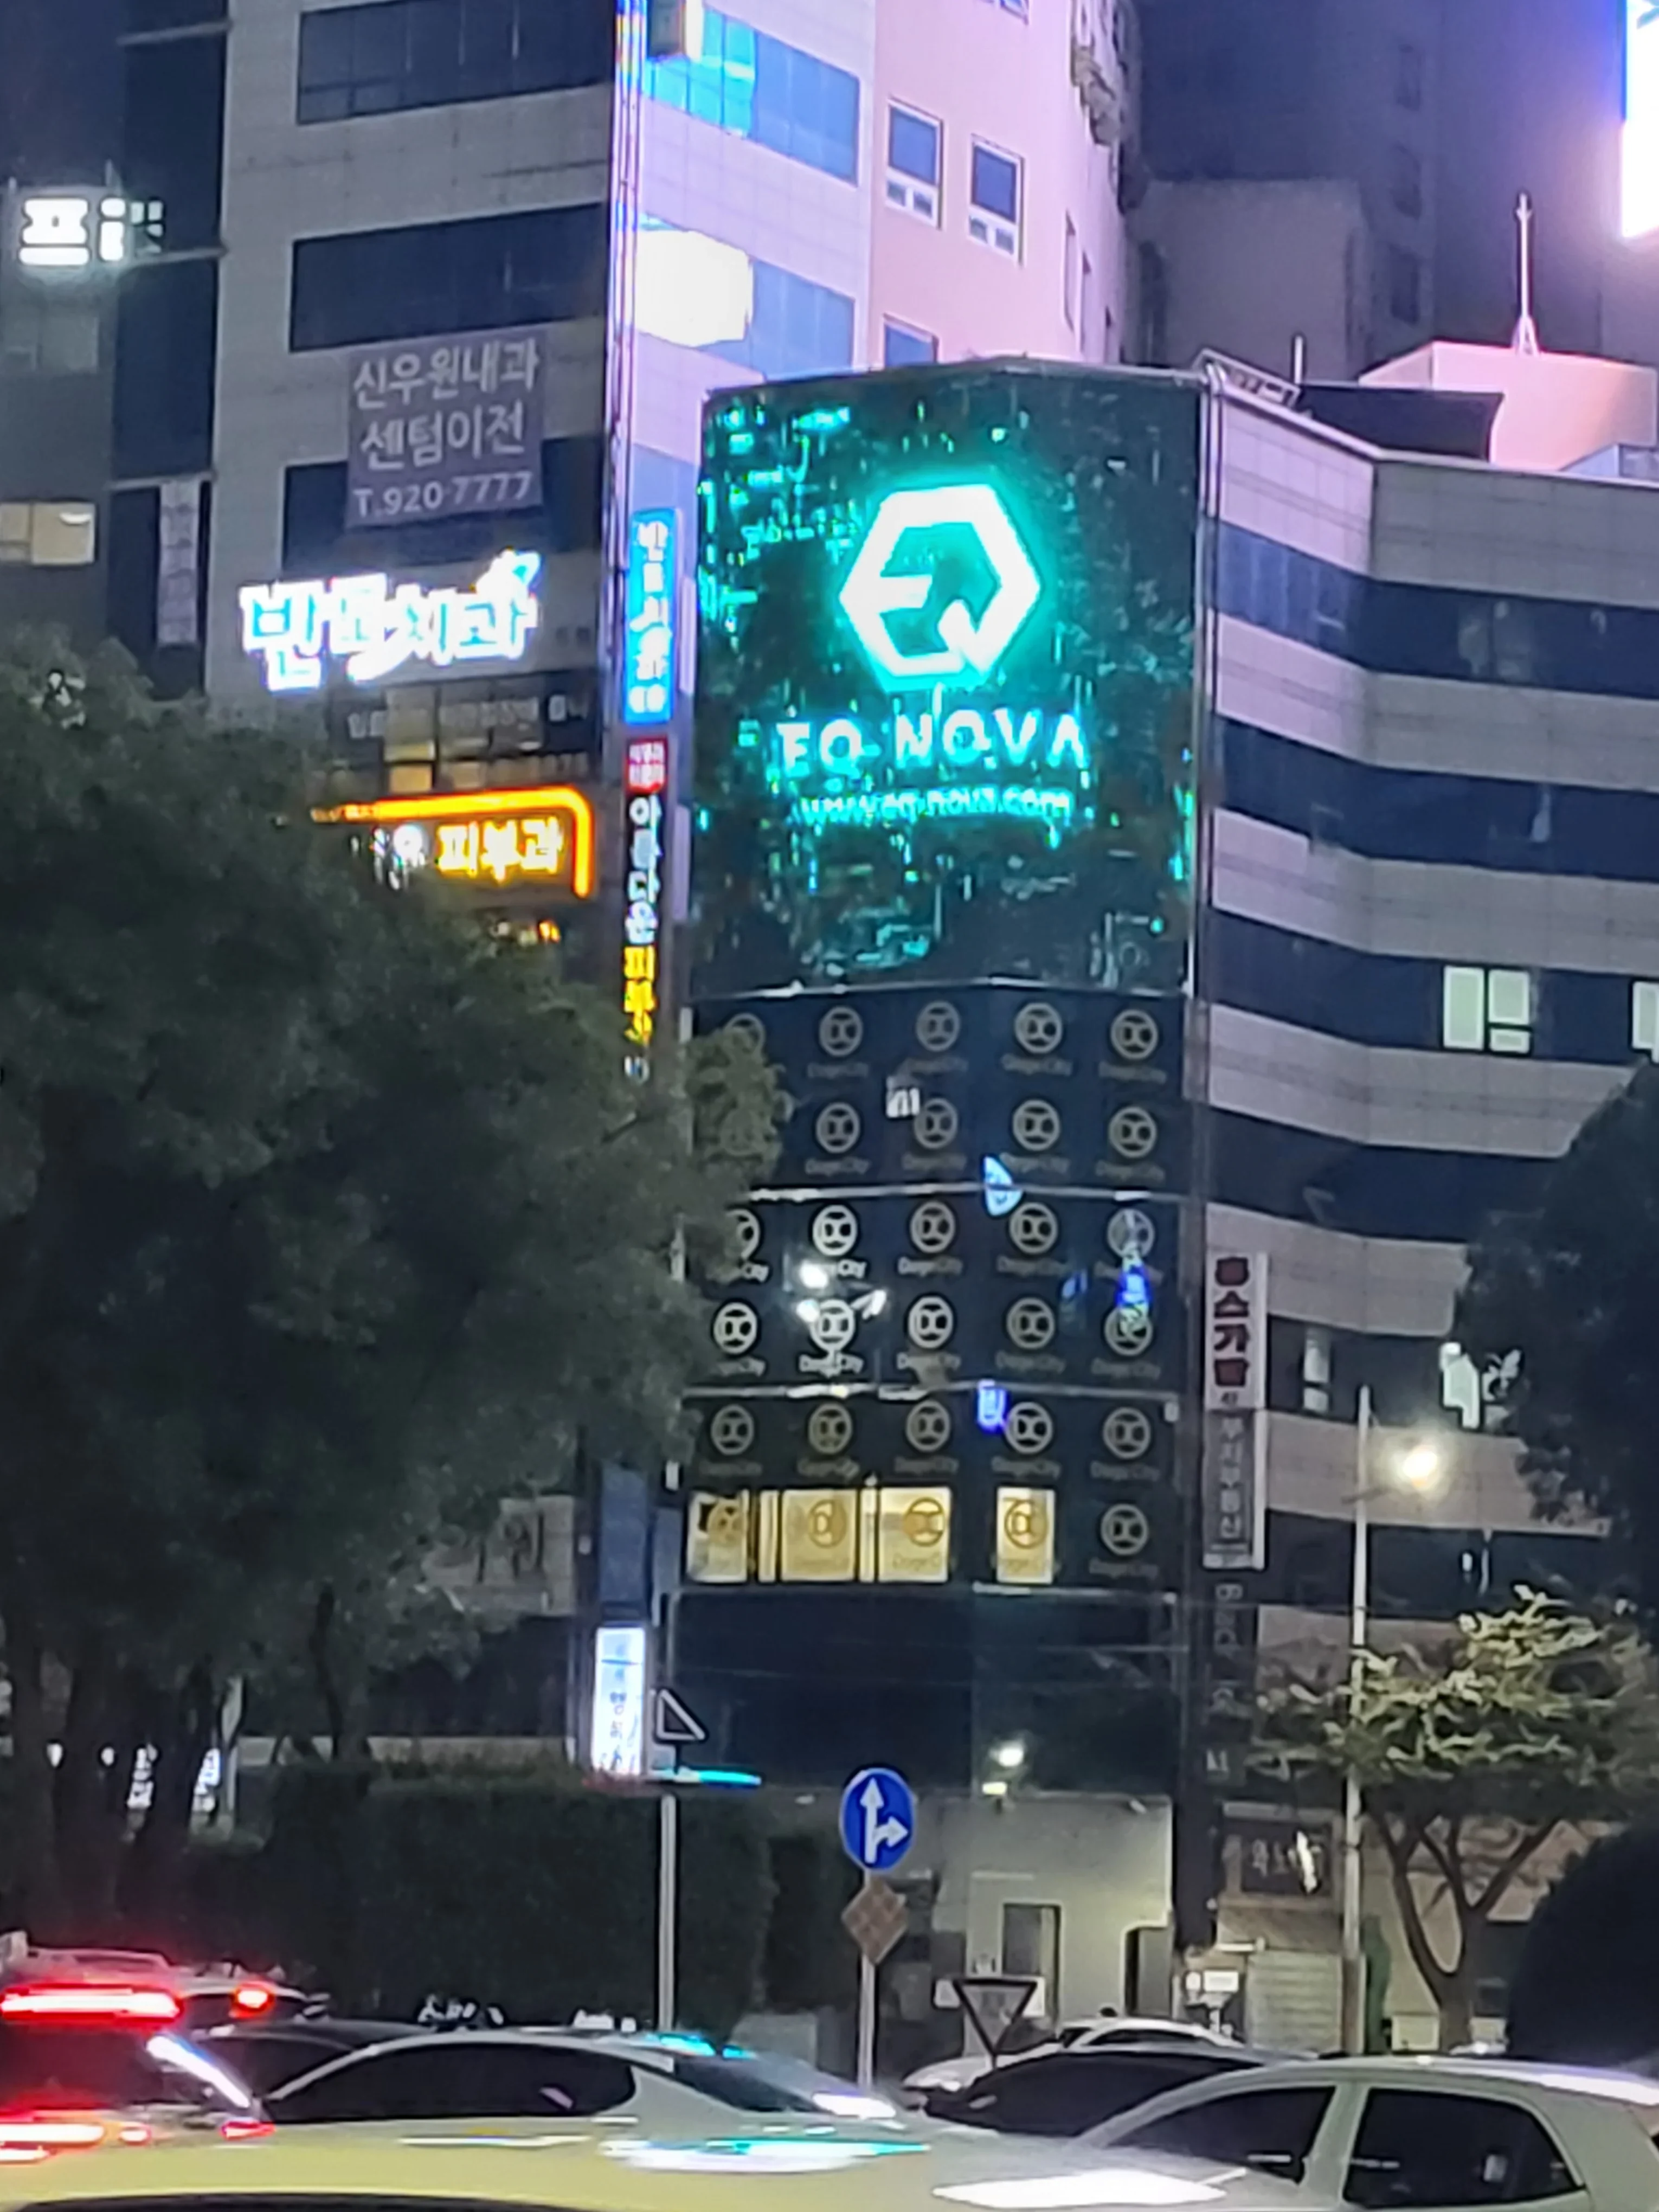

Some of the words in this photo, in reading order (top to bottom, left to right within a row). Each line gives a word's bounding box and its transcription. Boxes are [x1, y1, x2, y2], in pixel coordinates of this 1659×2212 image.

[353, 337, 540, 409] 신우원내과
[360, 398, 525, 471] 센텀이전
[436, 816, 564, 883] 피부과
